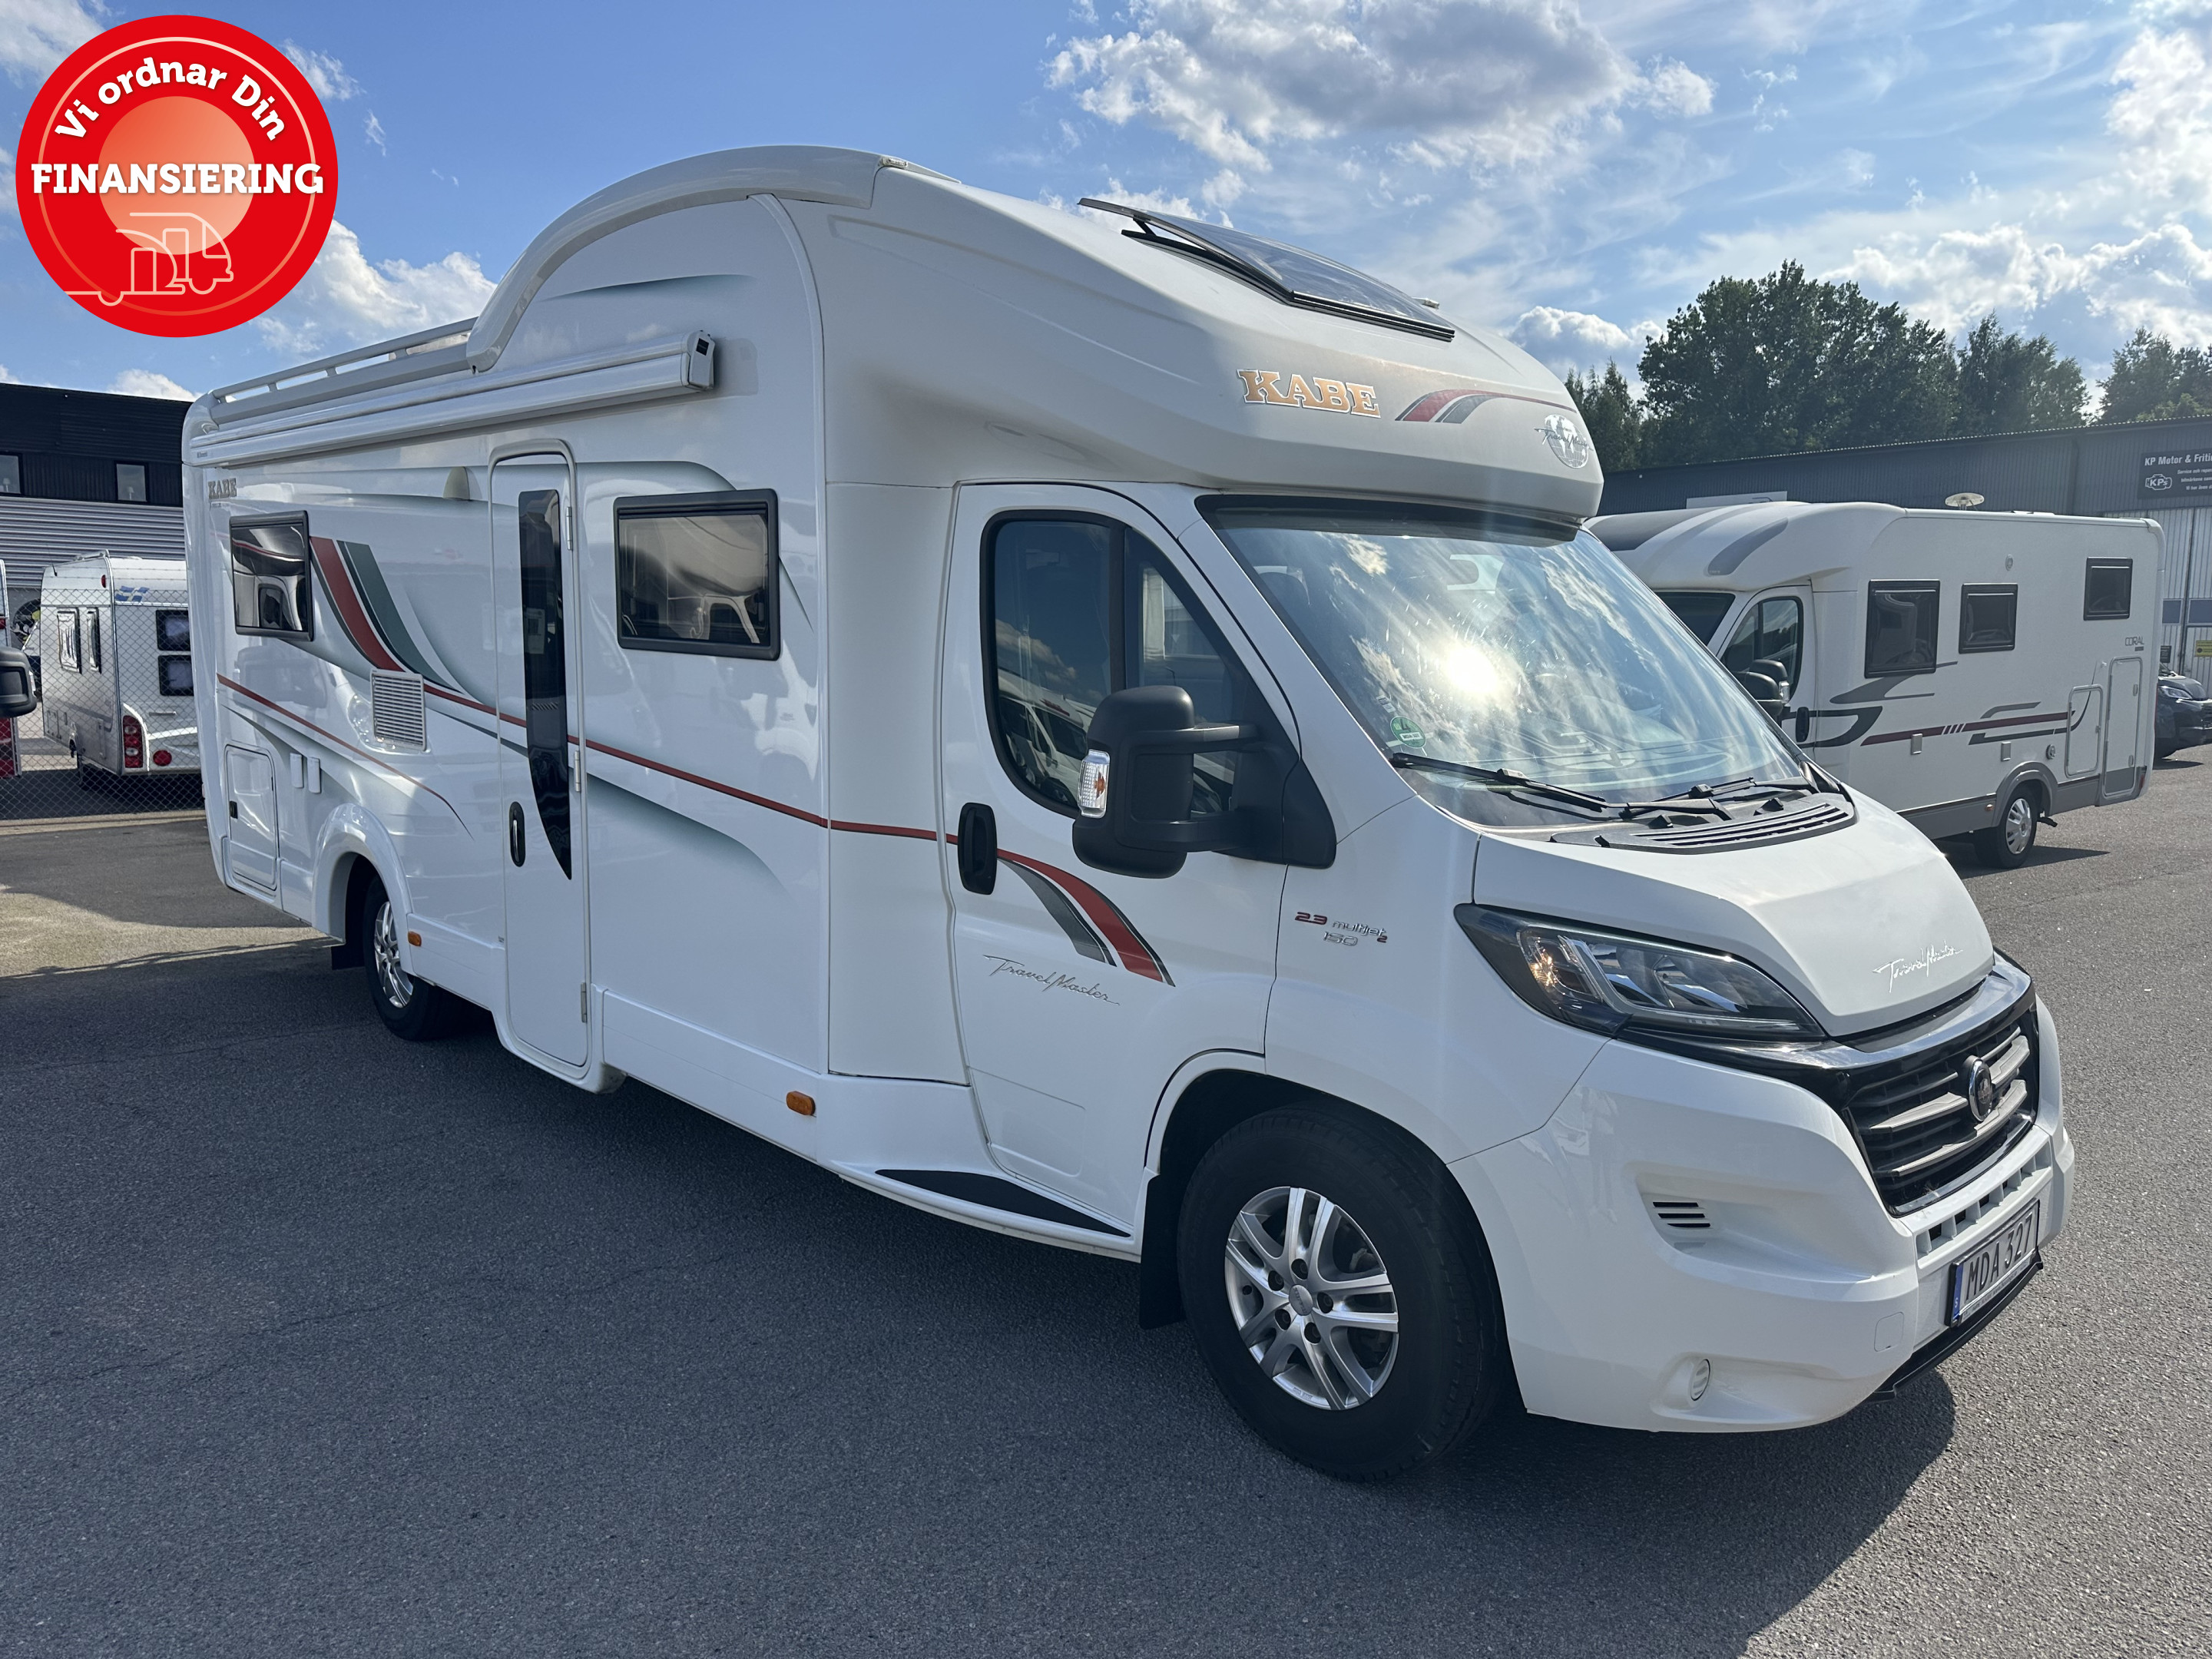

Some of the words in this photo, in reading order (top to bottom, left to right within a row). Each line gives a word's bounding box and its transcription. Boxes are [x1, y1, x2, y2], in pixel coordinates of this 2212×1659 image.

[1237, 369, 1381, 418] KABE
[2144, 457, 2156, 466] KP
[2158, 456, 2183, 465] Motor
[2184, 455, 2191, 463] &
[208, 478, 237, 499] KABE
[1332, 921, 1387, 936] multijet
[1323, 932, 1358, 946] 150
[982, 954, 1058, 984] Travel
[1041, 974, 1121, 1006] Master
[1966, 1241, 1999, 1300] MDA
[2004, 1210, 2033, 1269] 327
[1955, 1297, 1959, 1308] S
